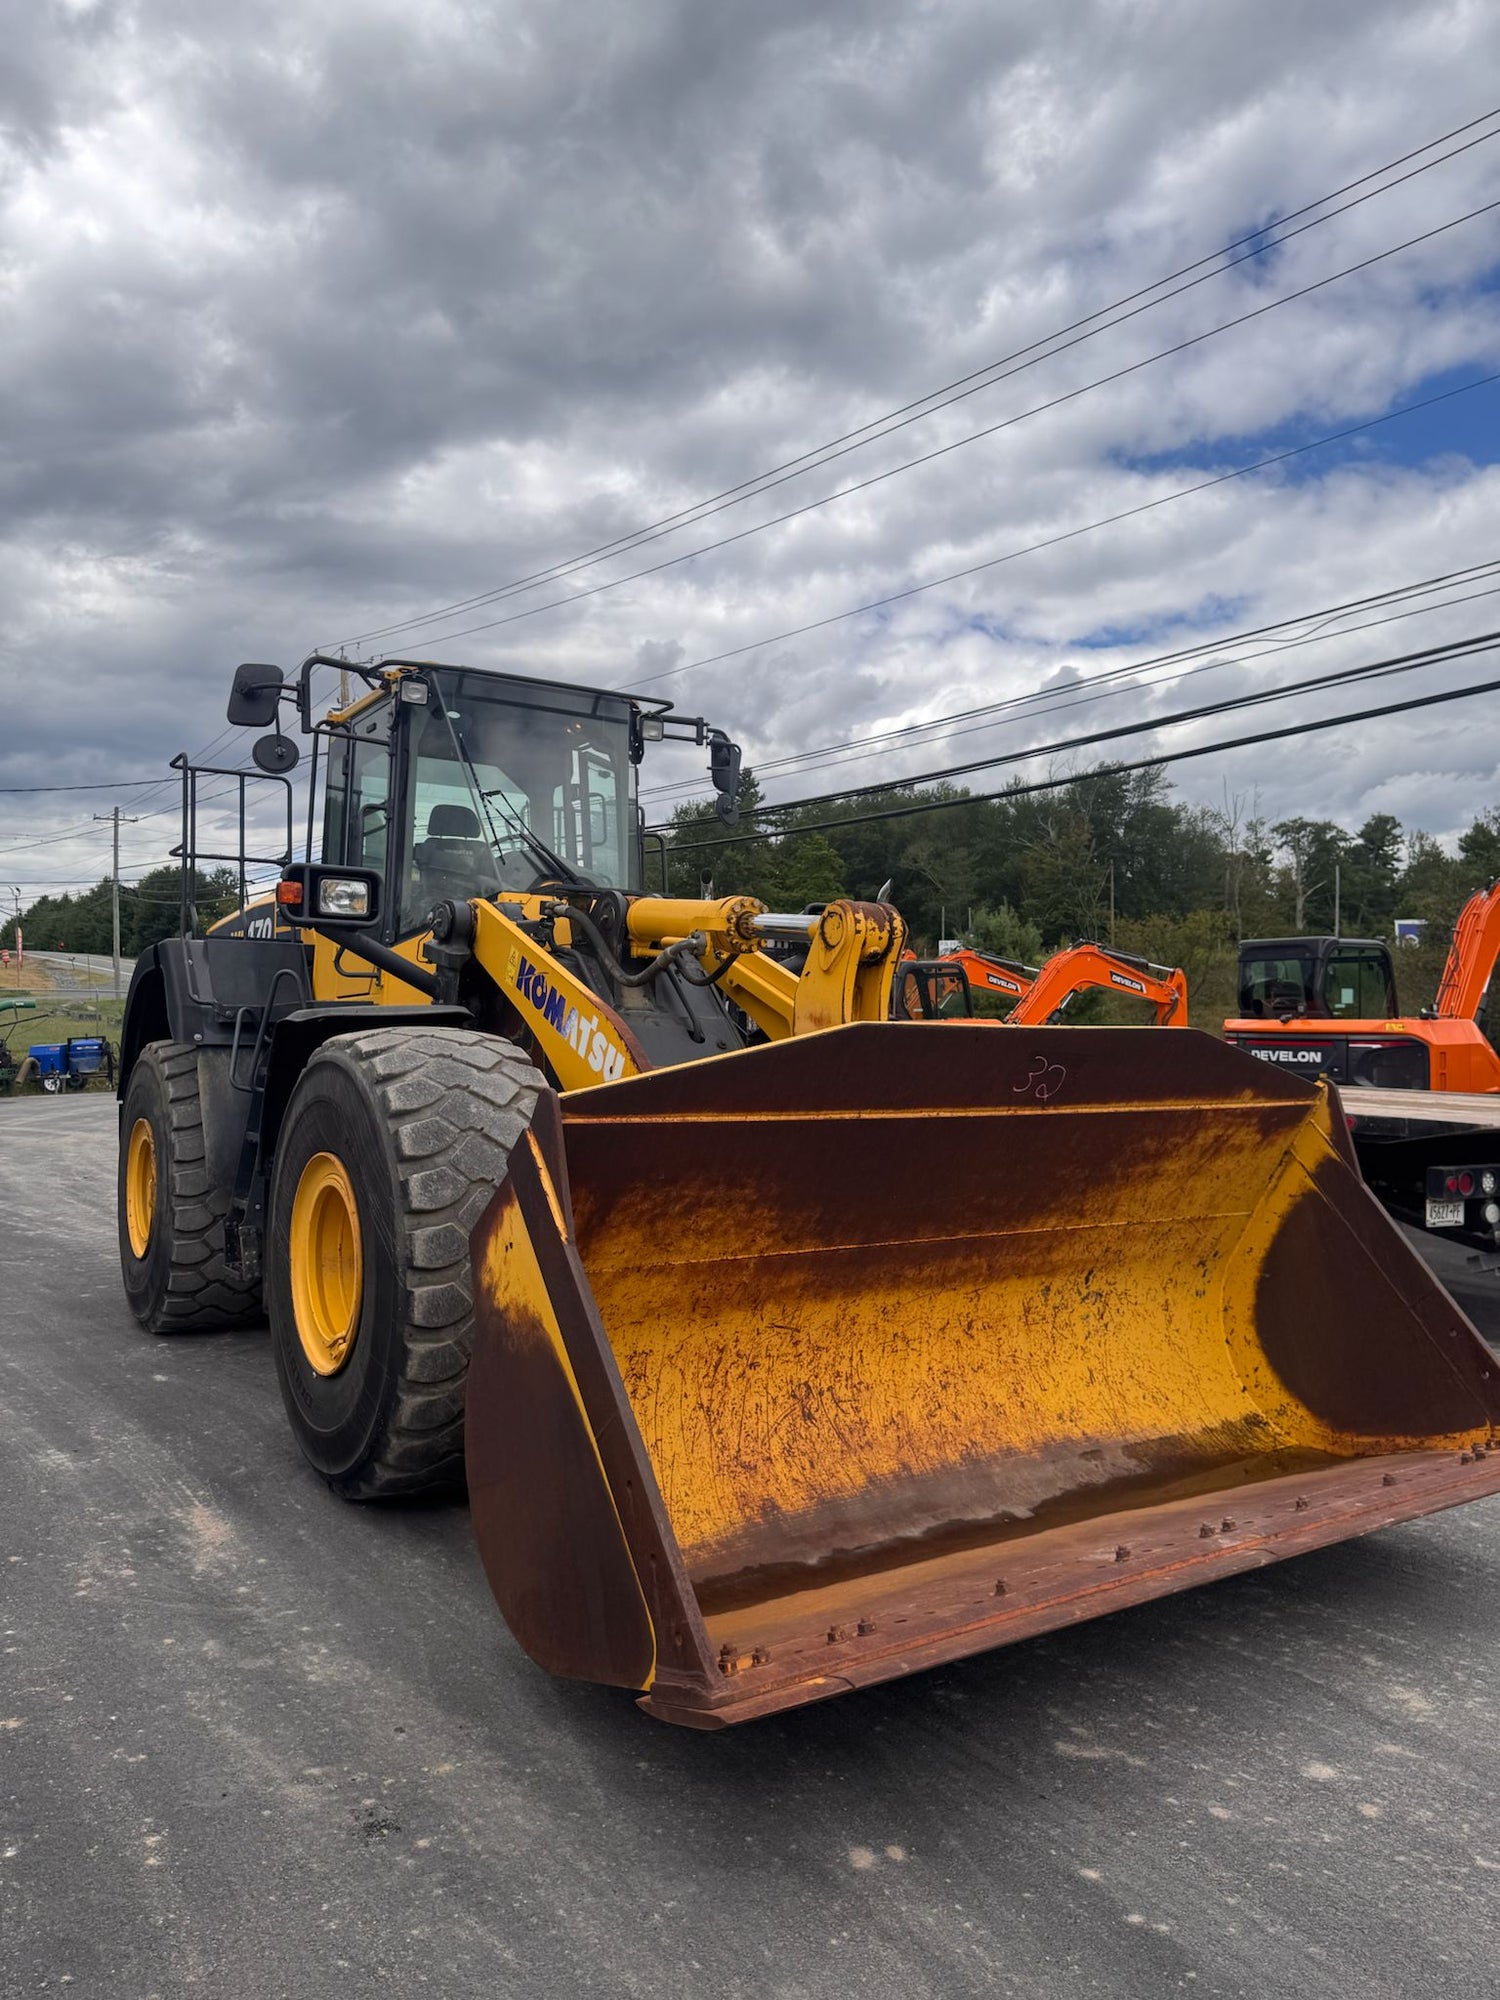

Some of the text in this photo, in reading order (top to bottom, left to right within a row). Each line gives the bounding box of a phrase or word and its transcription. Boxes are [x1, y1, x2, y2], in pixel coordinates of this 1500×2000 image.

[988, 974, 1017, 991] DEVELON
[1112, 973, 1141, 991] DEVELON
[515, 956, 625, 1082] KOMATSU
[1251, 1049, 1322, 1063] DEVELON
